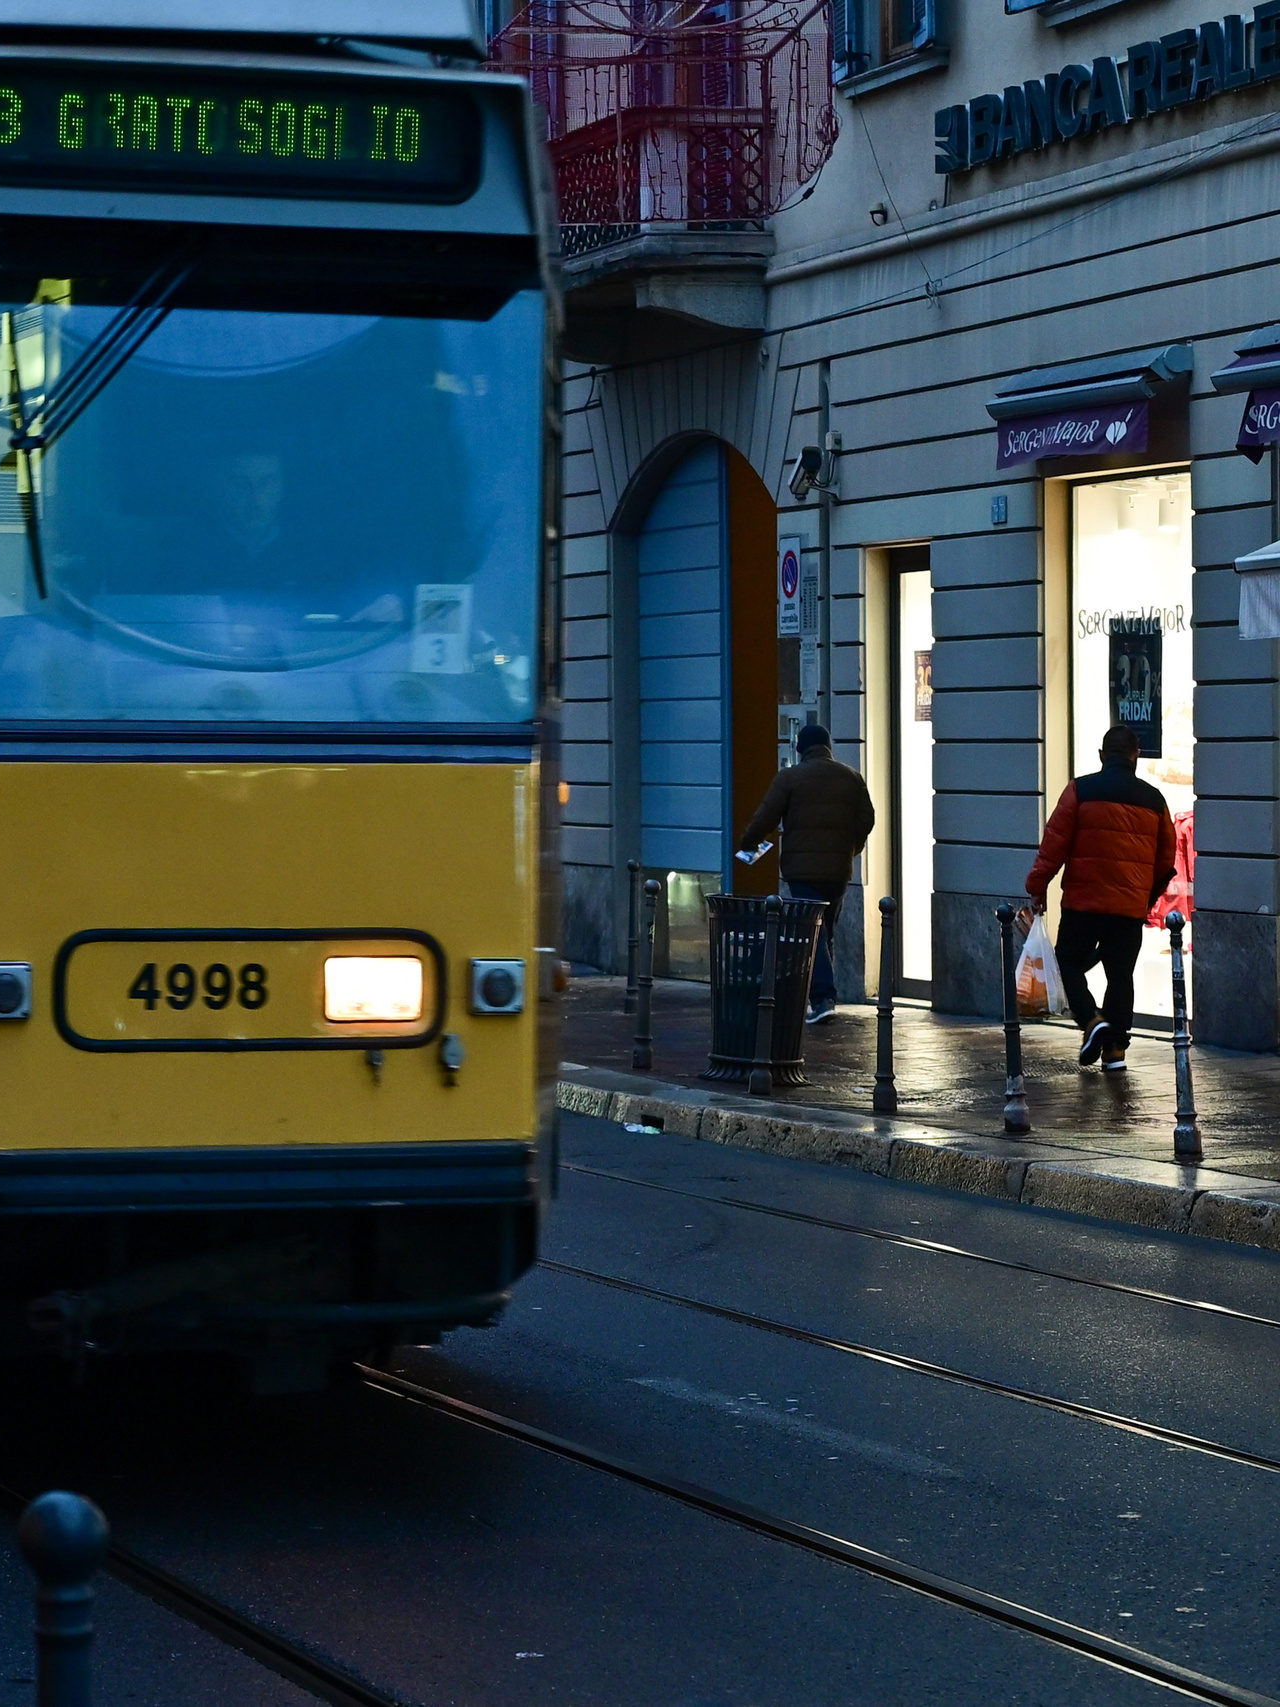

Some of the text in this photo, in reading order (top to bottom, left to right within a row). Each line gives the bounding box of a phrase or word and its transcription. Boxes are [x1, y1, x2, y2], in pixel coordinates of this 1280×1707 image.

[969, 57, 1128, 164] BANCA
[1119, 701, 1152, 721] FRIDAY
[129, 963, 268, 1011] 4998
